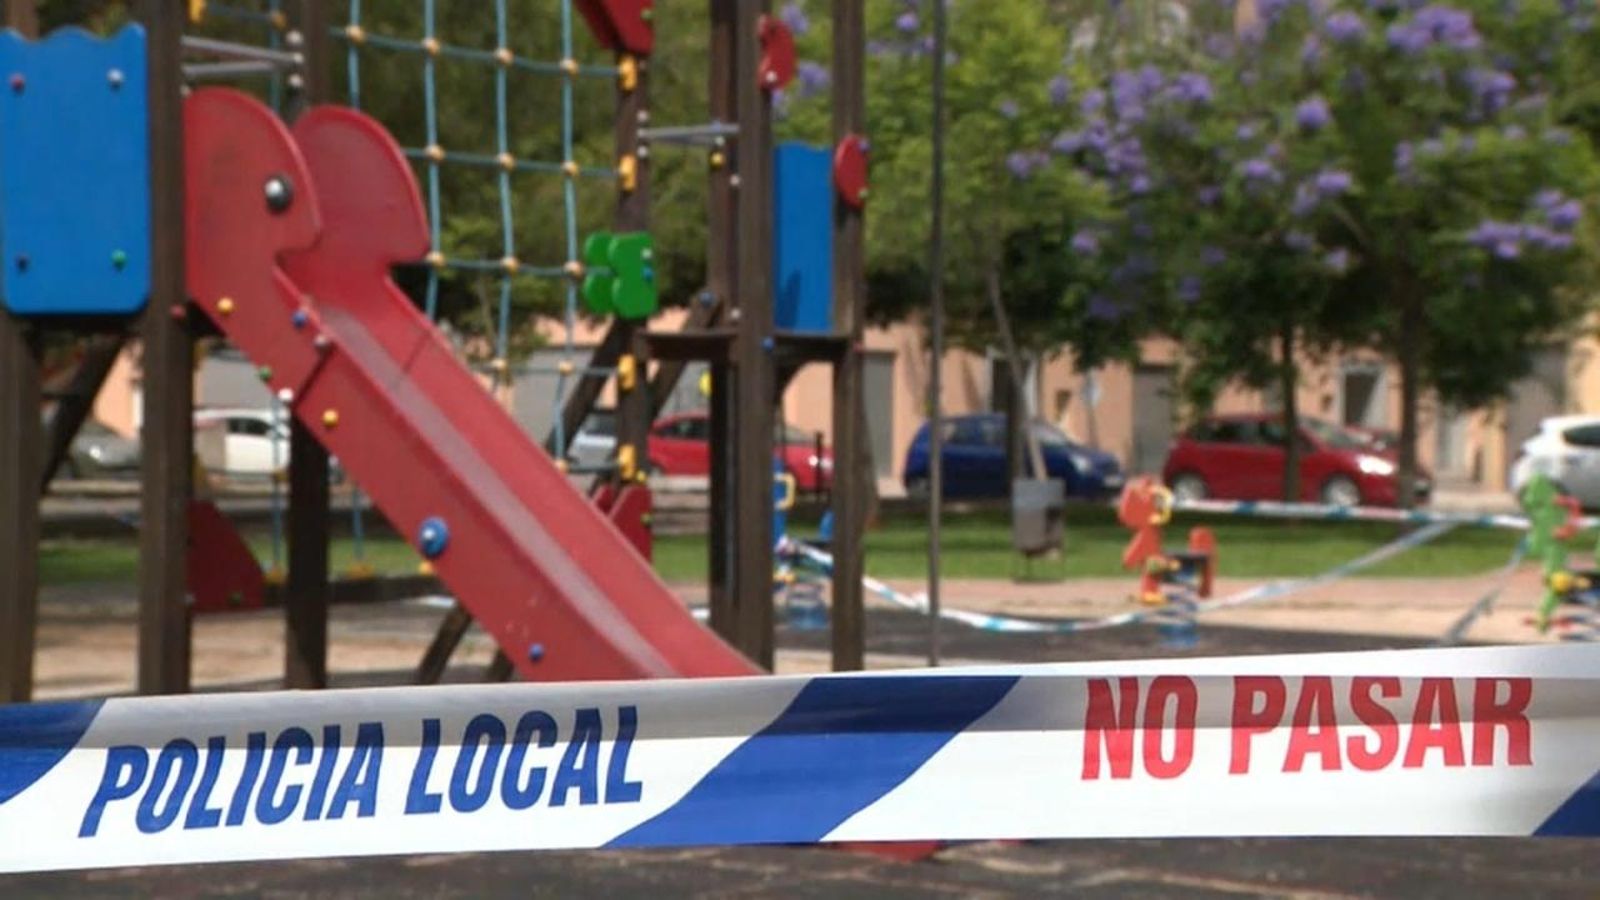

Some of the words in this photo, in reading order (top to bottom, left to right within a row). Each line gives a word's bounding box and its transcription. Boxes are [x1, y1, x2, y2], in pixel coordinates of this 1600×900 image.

[78, 722, 384, 838] POLICIA
[404, 705, 643, 814] LOCAL
[1081, 675, 1198, 780] NO
[1229, 676, 1534, 774] PASAR
